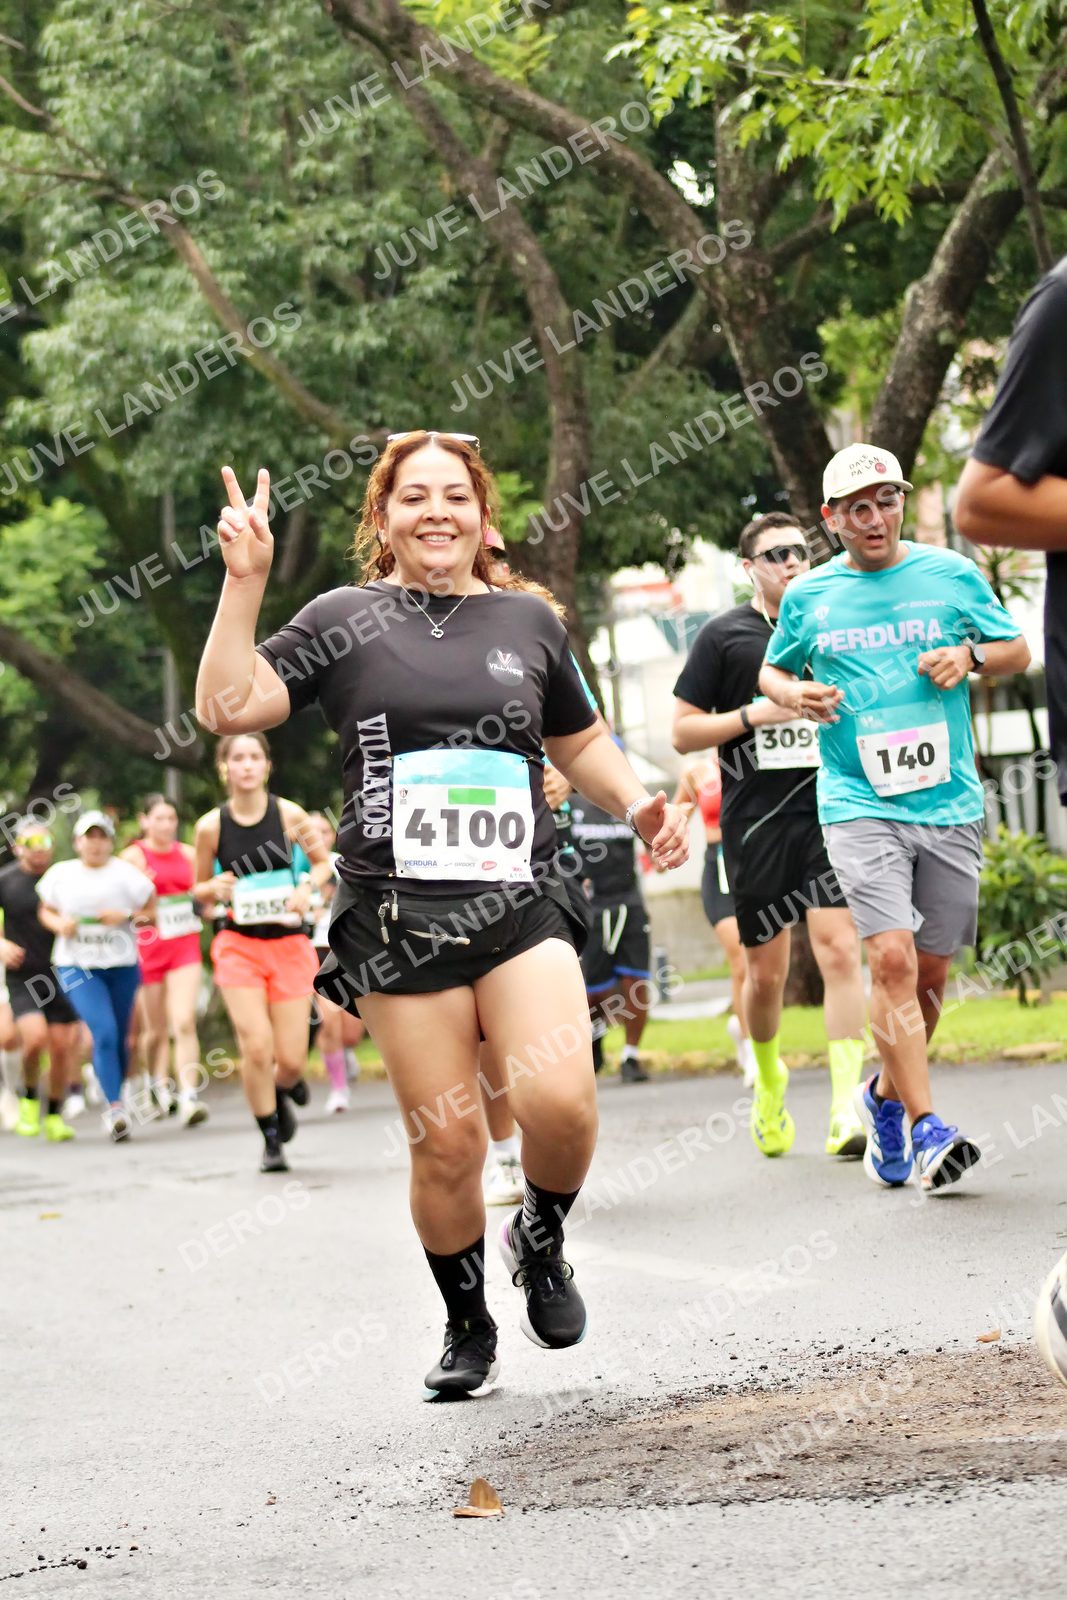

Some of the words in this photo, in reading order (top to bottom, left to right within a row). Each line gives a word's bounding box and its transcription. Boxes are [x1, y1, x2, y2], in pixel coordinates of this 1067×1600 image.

[817, 618, 942, 655] PERDURA
[762, 727, 819, 750] 309
[356, 713, 392, 839] VILLANOS
[876, 742, 935, 774] 140
[405, 808, 526, 849] 4100
